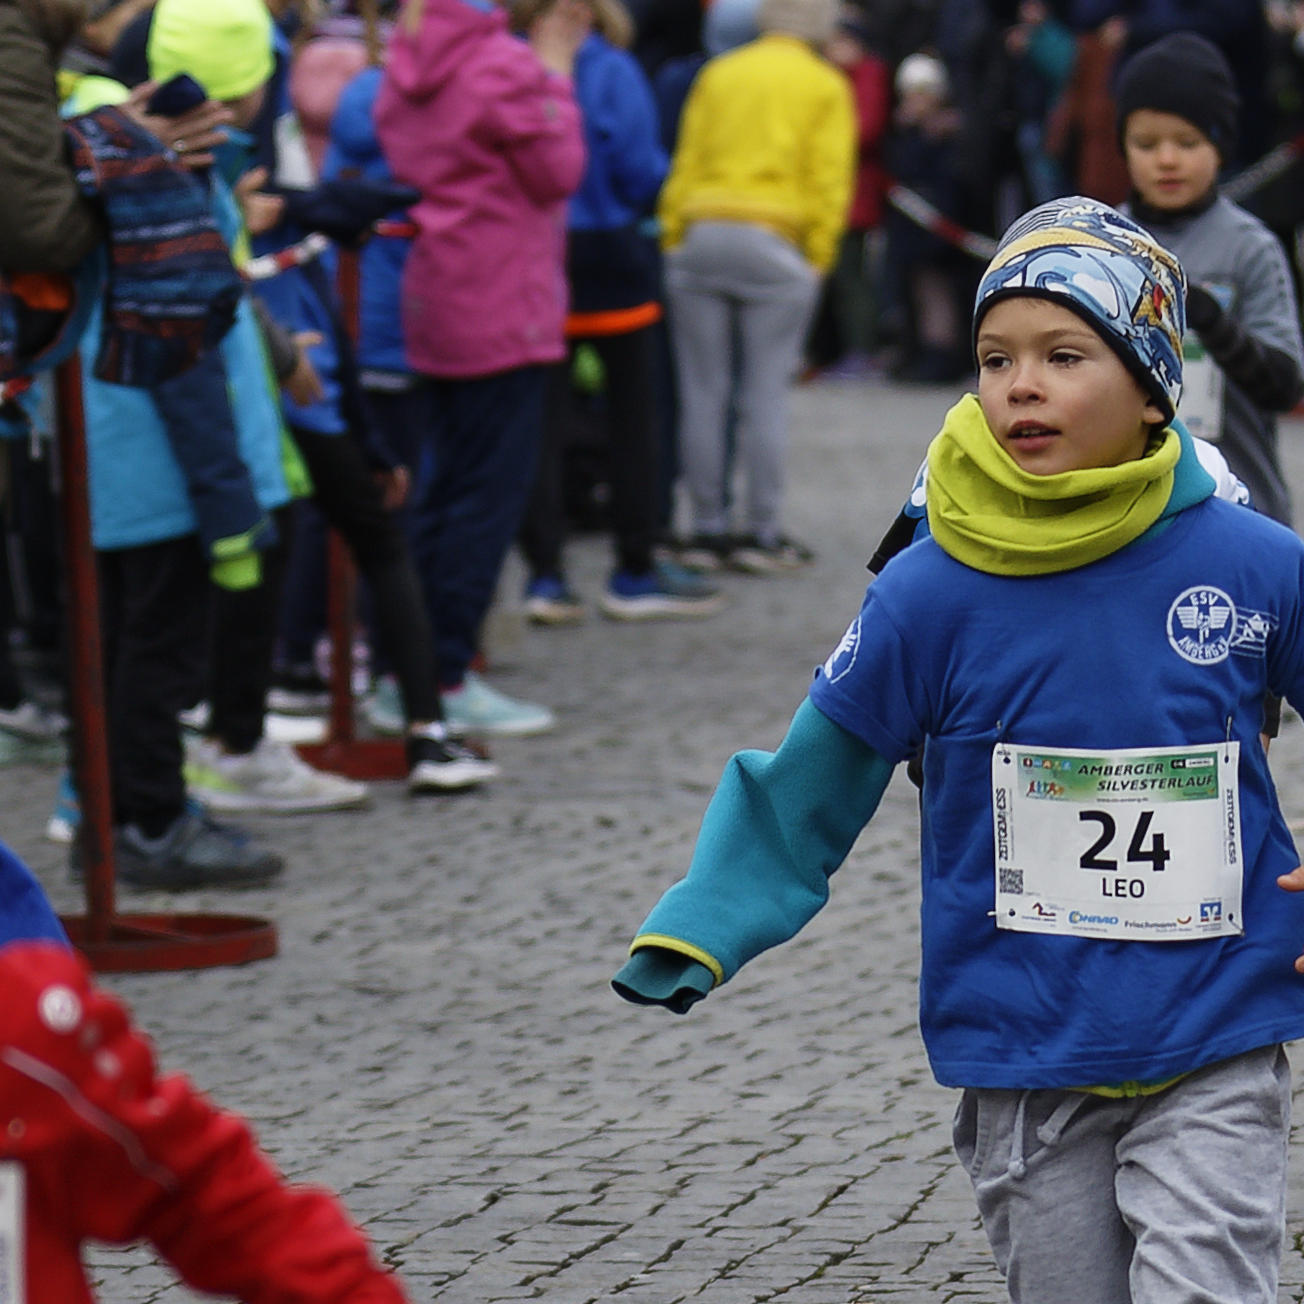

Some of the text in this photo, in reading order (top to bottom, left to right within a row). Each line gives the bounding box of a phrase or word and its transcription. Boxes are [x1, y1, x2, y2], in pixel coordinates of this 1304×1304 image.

[1190, 591, 1218, 606] ESV
[1078, 762, 1164, 776] AMBERGER
[1097, 775, 1214, 792] SILVESTERLAUF
[1079, 810, 1171, 871] 24
[1102, 877, 1145, 898] LEO
[1124, 919, 1177, 928] Frischmann
